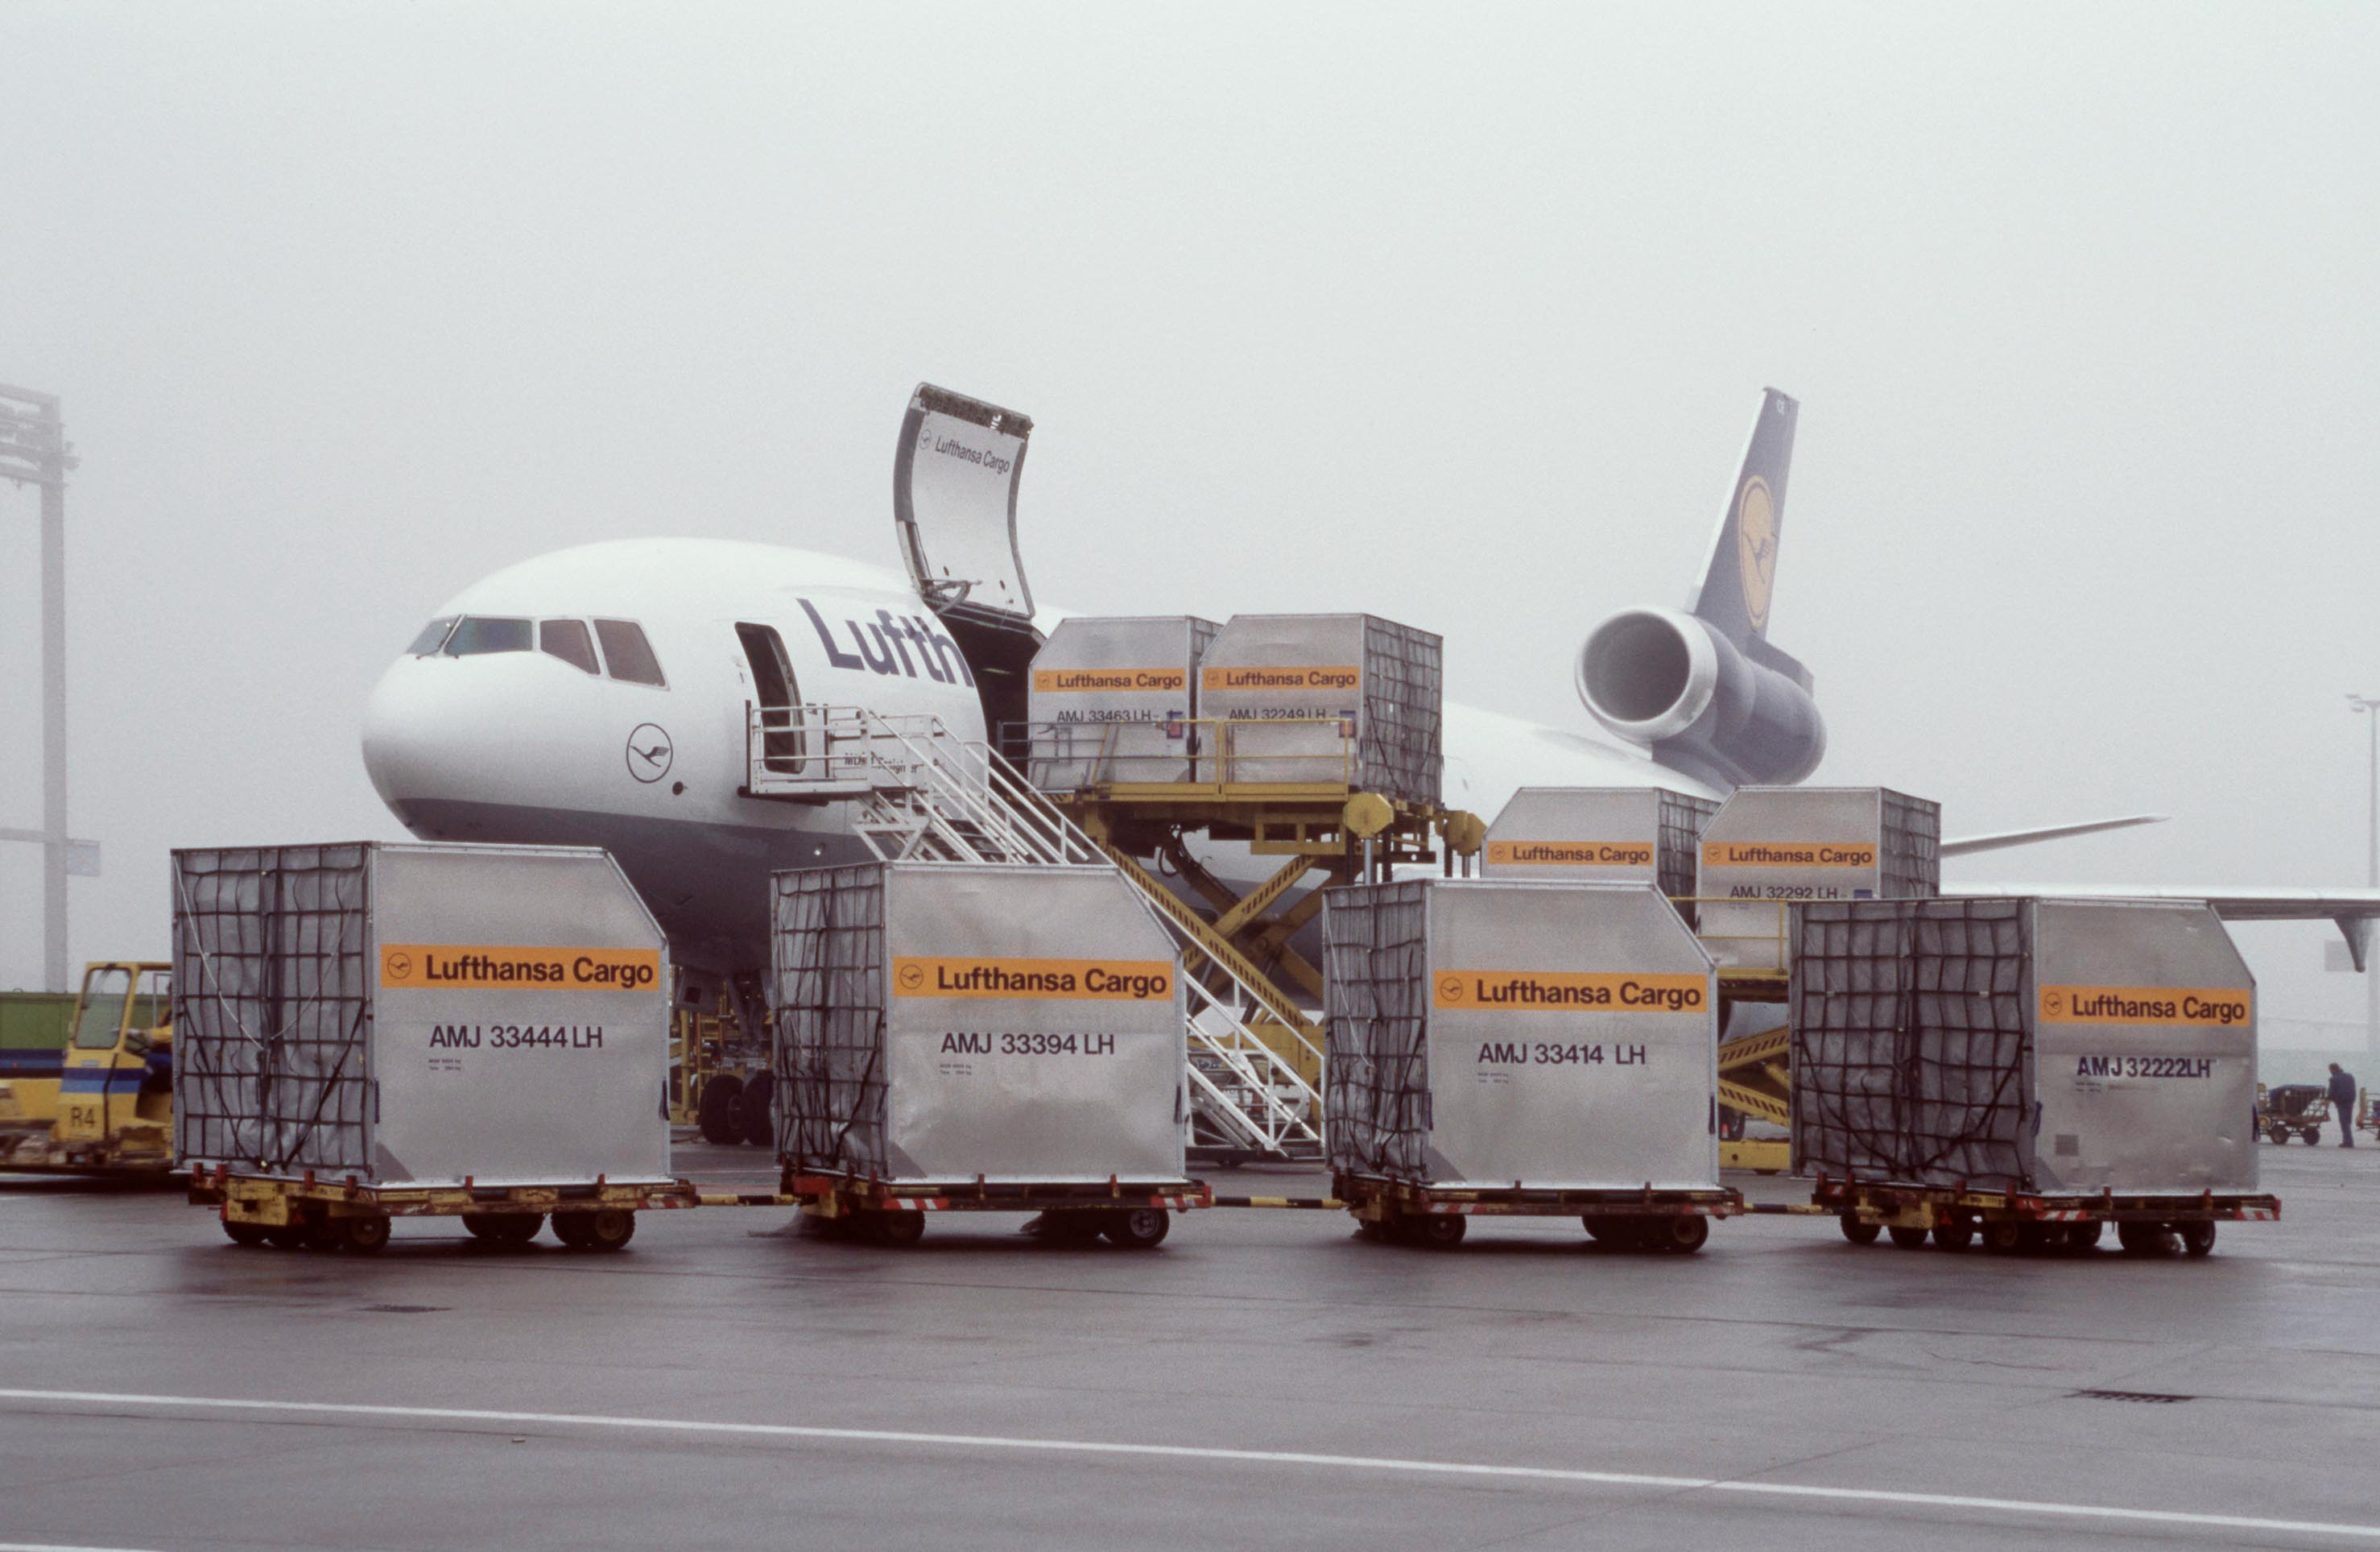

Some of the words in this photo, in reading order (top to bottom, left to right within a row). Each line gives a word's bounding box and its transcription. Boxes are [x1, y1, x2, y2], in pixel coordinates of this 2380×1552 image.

[935, 436, 981, 463] Lufthansa
[983, 450, 1010, 474] Cargo
[1056, 673, 1132, 688] Lufthansa
[1135, 673, 1183, 689] Cargo
[1226, 671, 1304, 686] Lufthansa
[1308, 671, 1357, 689] Cargo
[1056, 710, 1085, 723] AMJ
[1089, 710, 1130, 722] 33463
[1134, 709, 1151, 722] LH
[1229, 709, 1257, 720] AMJ
[1262, 709, 1305, 720] 32249
[1512, 846, 1595, 862] Lufthansa
[1599, 846, 1650, 864] Cargo
[1729, 847, 1815, 863] Lufthansa
[1819, 848, 1872, 866] Cargo
[1730, 886, 1761, 899] AMJ
[1767, 886, 1813, 899] 32292
[1817, 887, 1838, 900] LH
[425, 954, 565, 982] Lufthansa
[572, 956, 653, 989] Cargo
[937, 966, 1076, 991] Lufthansa
[1085, 968, 1167, 999] Cargo
[1477, 979, 1611, 1004] Lufthansa
[1619, 981, 1701, 1011] Cargo
[2072, 994, 2176, 1018] Lufthansa
[2183, 995, 2245, 1024] Cargo
[429, 1025, 481, 1048] AMJ
[490, 1025, 568, 1048] 33444
[572, 1026, 603, 1048] LH
[940, 1033, 992, 1054] AMJ
[1001, 1033, 1078, 1055] 33394
[1083, 1034, 1115, 1055] LH
[1477, 1043, 1527, 1064] AMJ
[1535, 1044, 1605, 1065] 33414
[1614, 1045, 1646, 1065] LH
[2076, 1056, 2122, 1076] AMJ
[70, 1106, 96, 1128] R4
